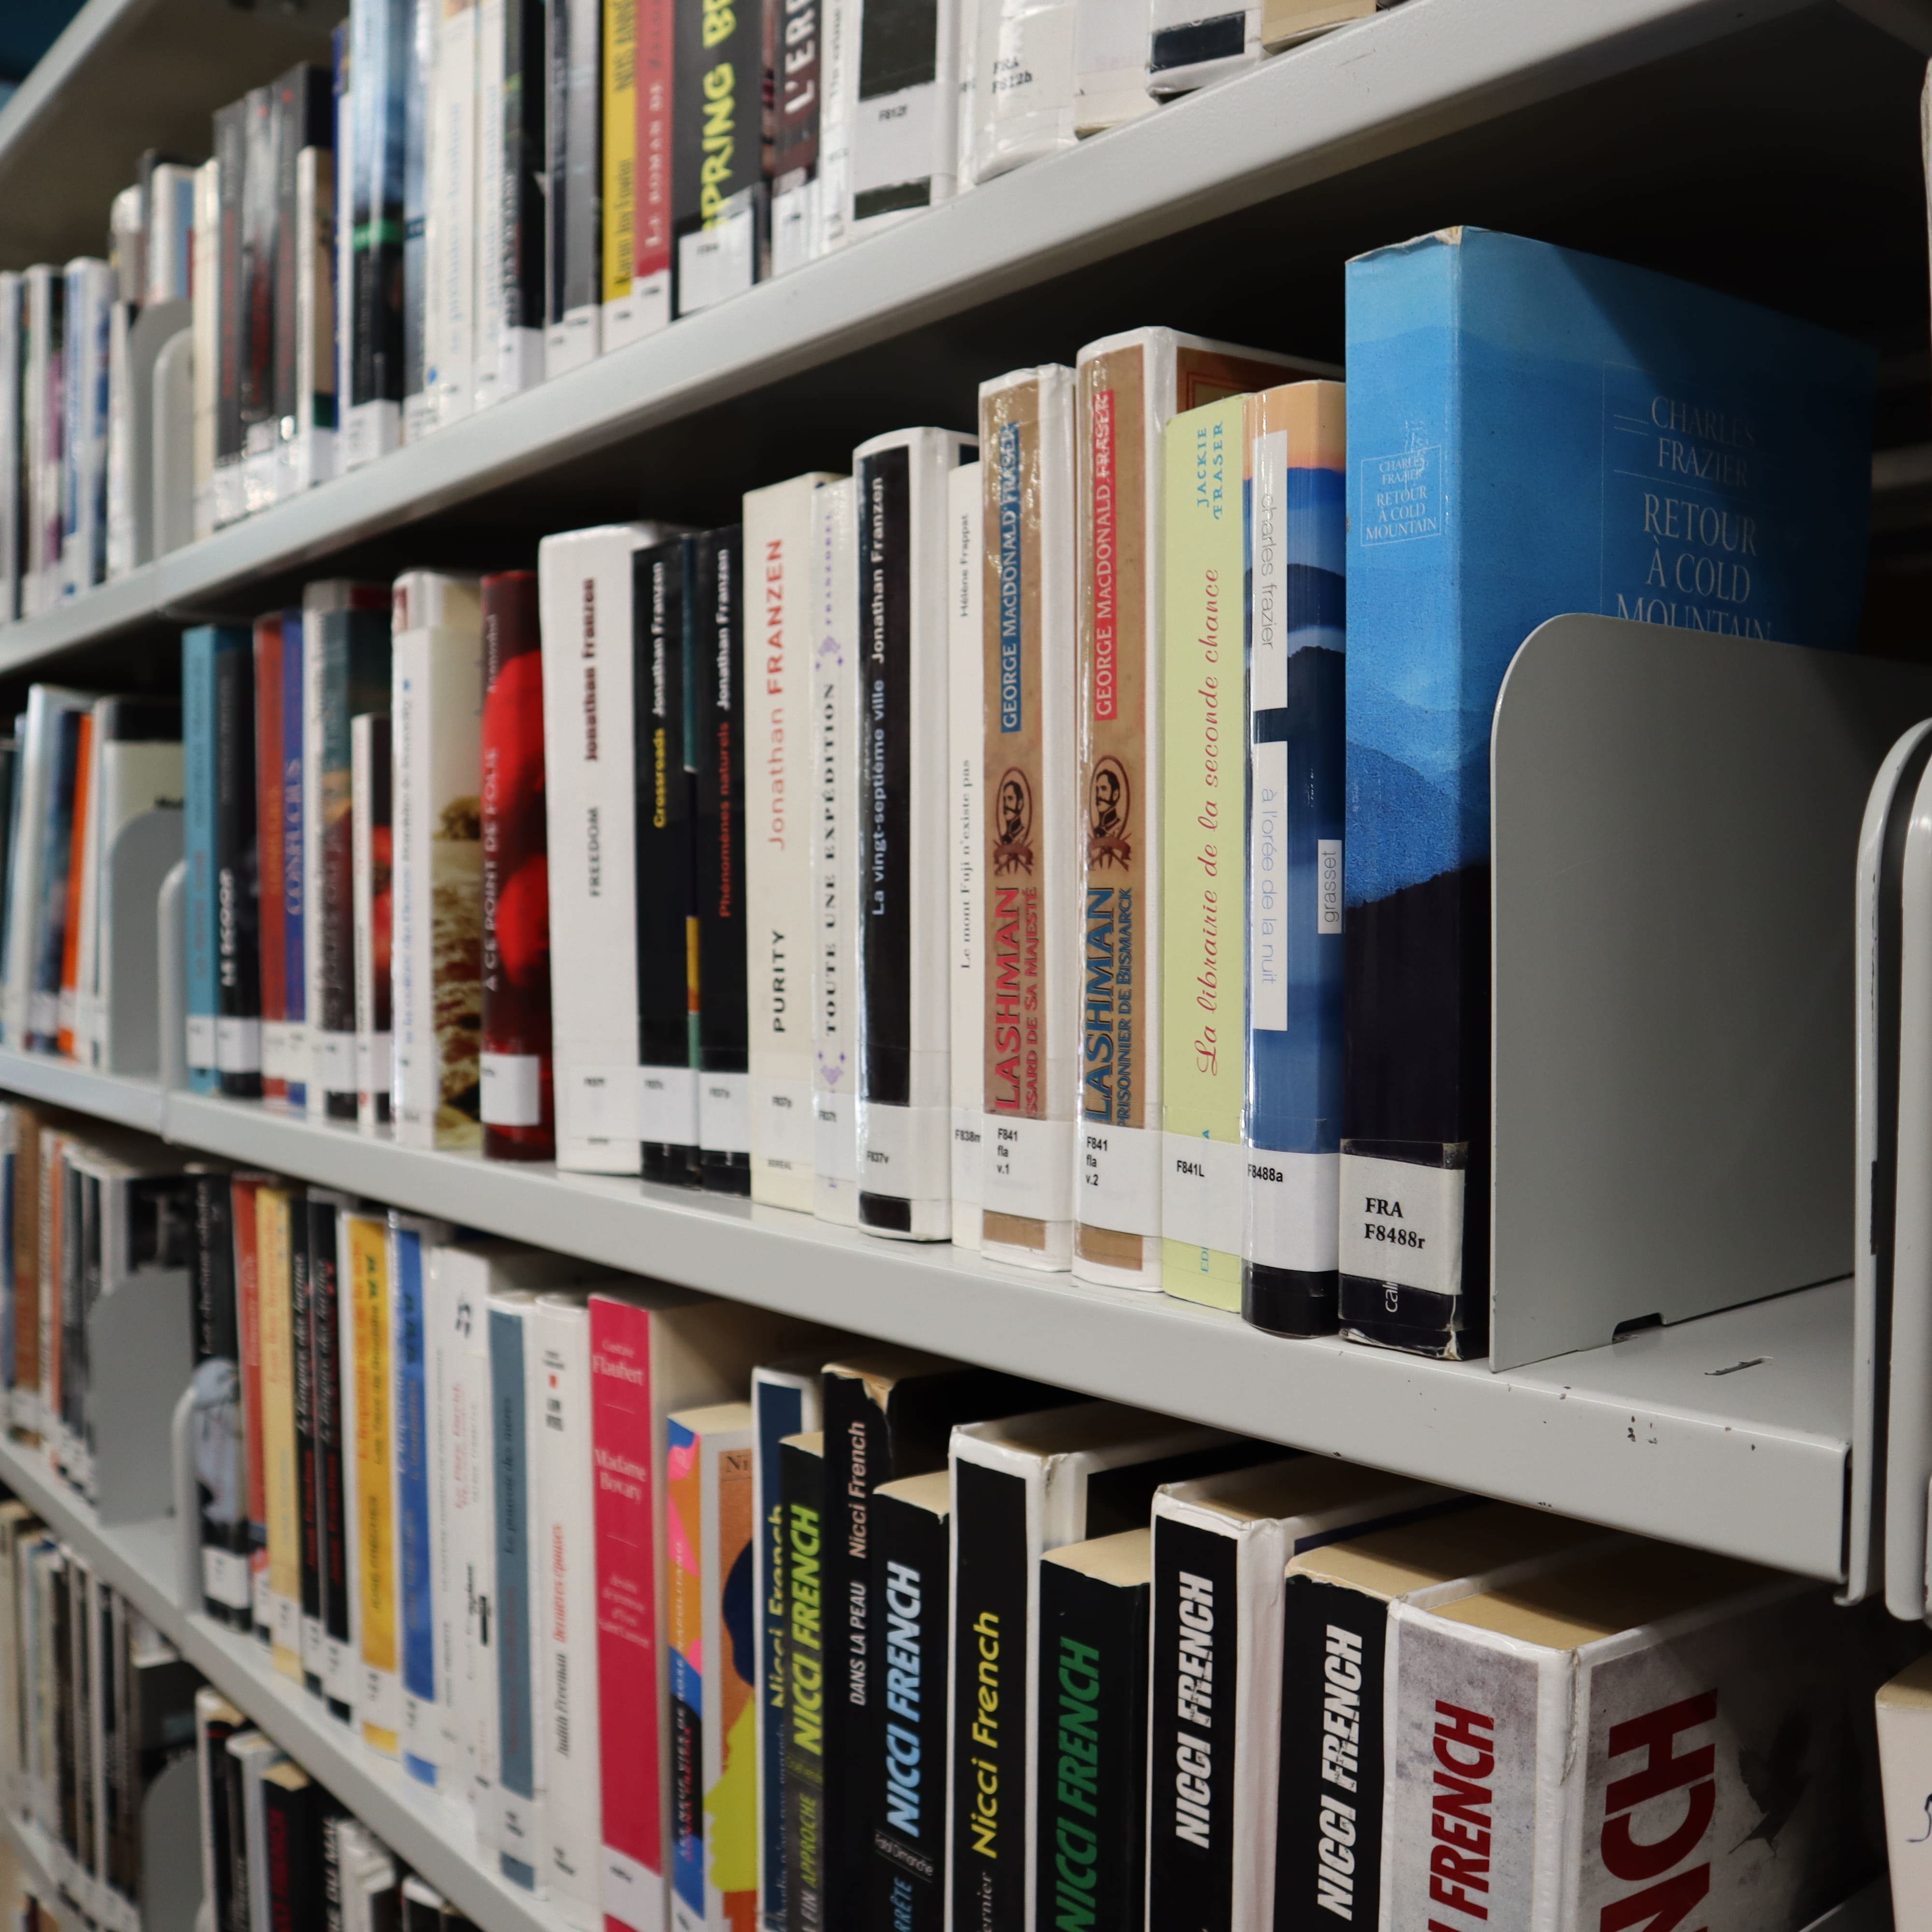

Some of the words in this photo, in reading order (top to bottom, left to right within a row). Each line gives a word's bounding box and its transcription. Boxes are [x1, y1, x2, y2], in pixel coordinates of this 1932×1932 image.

[1651, 395, 1756, 448] CHARLES
[1197, 427, 1209, 508] JACKIE
[1212, 421, 1224, 520] FRASER
[1376, 483, 1428, 507] RETOUR
[1378, 455, 1426, 474] CHARLES
[1381, 469, 1422, 485] FRAZIER
[1658, 437, 1748, 488] FRAZIER
[870, 477, 883, 563] Franzen
[1261, 493, 1278, 577] charles
[1365, 516, 1437, 540] MOUNTAIN
[1378, 505, 1388, 521] À
[1390, 502, 1426, 521] COLD
[1644, 492, 1758, 556] RETOUR
[650, 562, 664, 634] Franzen
[715, 549, 730, 624] Franzen
[1646, 535, 1666, 590] À
[1675, 553, 1750, 603] COLD
[766, 540, 783, 695] FRANZEN
[871, 569, 884, 665] Jonathan
[1198, 568, 1218, 664] chance
[1261, 582, 1278, 650] frazier
[651, 638, 665, 717] Jonathan
[716, 627, 731, 711] Jonathan
[872, 679, 884, 722] ville
[1002, 643, 1018, 728] GEORGE
[1096, 625, 1112, 716] GEORGE
[717, 722, 730, 796] naturels
[1197, 676, 1219, 788] seconde
[652, 728, 666, 829] Crossroads
[767, 708, 784, 851] Jonathan
[821, 683, 835, 861] EXPÉDITION
[871, 728, 887, 882] vingt-septième
[961, 760, 973, 787] pas
[1261, 788, 1277, 803] à
[960, 793, 970, 856] n'existe
[1197, 801, 1218, 832] la
[1261, 811, 1278, 871] l'orée
[586, 807, 601, 897] FREEDOM
[960, 861, 973, 894] Fuji
[1196, 844, 1218, 877] de
[1322, 850, 1339, 923] grasset
[824, 875, 836, 929] UNE
[872, 890, 884, 915] La
[962, 901, 970, 942] mont
[1261, 879, 1277, 910] de
[1261, 918, 1277, 935] la
[960, 948, 970, 969] Le
[1022, 887, 1039, 978] MAJESTÉ
[1116, 887, 1132, 985] BISMARCK
[1196, 890, 1218, 1013] librairie
[1261, 944, 1277, 984] nuit
[771, 929, 785, 1033] PURITY
[824, 942, 836, 1037] TOUTE
[994, 887, 1021, 1110] LASHMAN
[1085, 887, 1113, 1122] LASHMAN
[1116, 989, 1131, 1015] DE
[1025, 1017, 1037, 1044] DE
[1193, 1024, 1218, 1078] La
[997, 1127, 1018, 1143] F841
[997, 1145, 1009, 1159] fla
[997, 1163, 1009, 1176] v.1
[1086, 1135, 1108, 1152] F841
[1086, 1153, 1097, 1167] fla
[1177, 1159, 1205, 1179] F841L
[1085, 1173, 1099, 1186] v.2
[1247, 1163, 1283, 1183] F8488a
[1364, 1196, 1404, 1220] FRA
[1364, 1223, 1426, 1250] F8488r
[848, 1421, 867, 1499] French
[849, 1505, 867, 1559] Nicci
[791, 1505, 821, 1650] FRENCH
[850, 1582, 867, 1630] PEAU
[850, 1634, 867, 1656] LA
[886, 1561, 921, 1722] FRENCH
[1177, 1571, 1214, 1728] FRENCH
[554, 1653, 567, 1714] Freeman
[792, 1652, 822, 1756] NICCI
[850, 1660, 867, 1706] DANS
[972, 1611, 999, 1749] French
[1321, 1624, 1363, 1792] FRENCH
[1056, 1637, 1100, 1818] FRENCH
[886, 1722, 921, 1838] NICCI
[971, 1757, 997, 1859] Nicci
[1175, 1731, 1212, 1849] NICCI
[1429, 1699, 1495, 1921] FRENCH
[799, 1791, 818, 1888] APPROCHE
[1055, 1817, 1098, 1932] NICCI
[1317, 1794, 1357, 1921] NICCI
